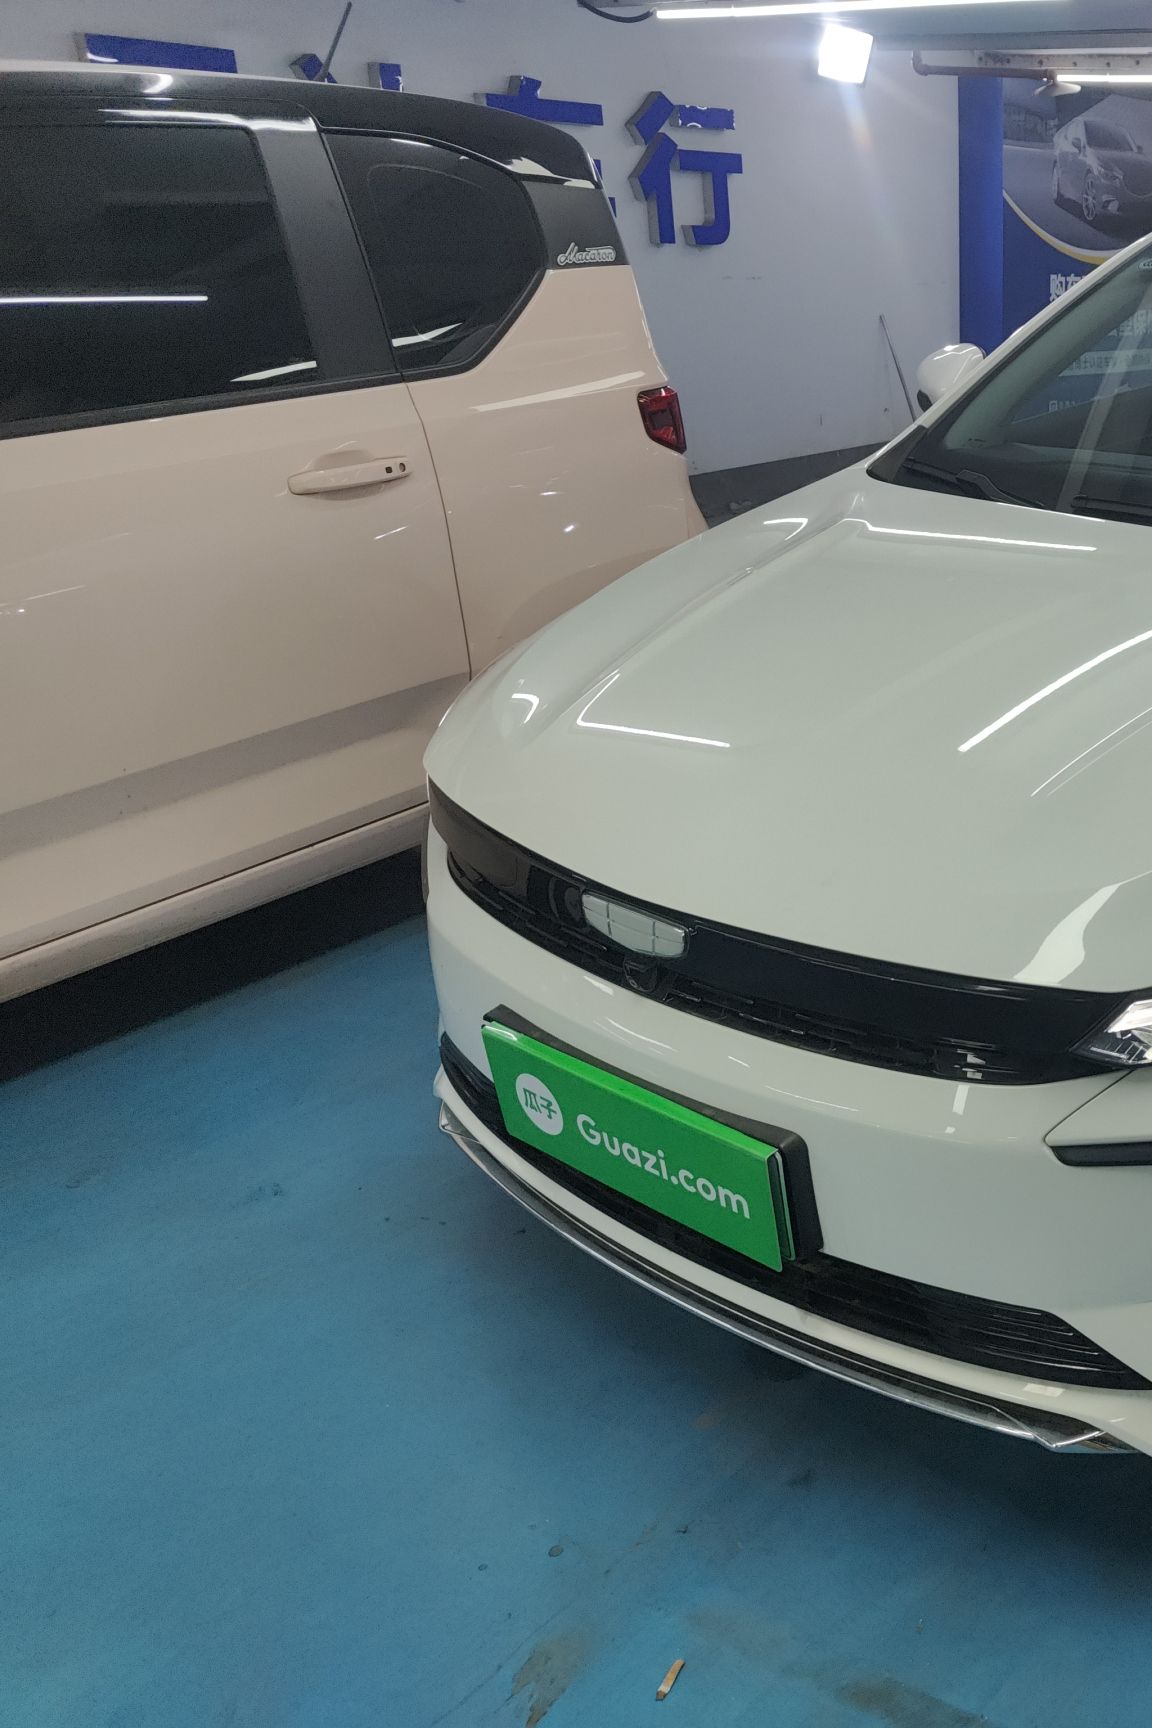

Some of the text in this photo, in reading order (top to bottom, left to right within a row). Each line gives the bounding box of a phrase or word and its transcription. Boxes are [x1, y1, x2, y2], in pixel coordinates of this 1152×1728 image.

[557, 242, 616, 265] Macaron
[523, 1087, 750, 1220] 瓜子 Guazi.com
